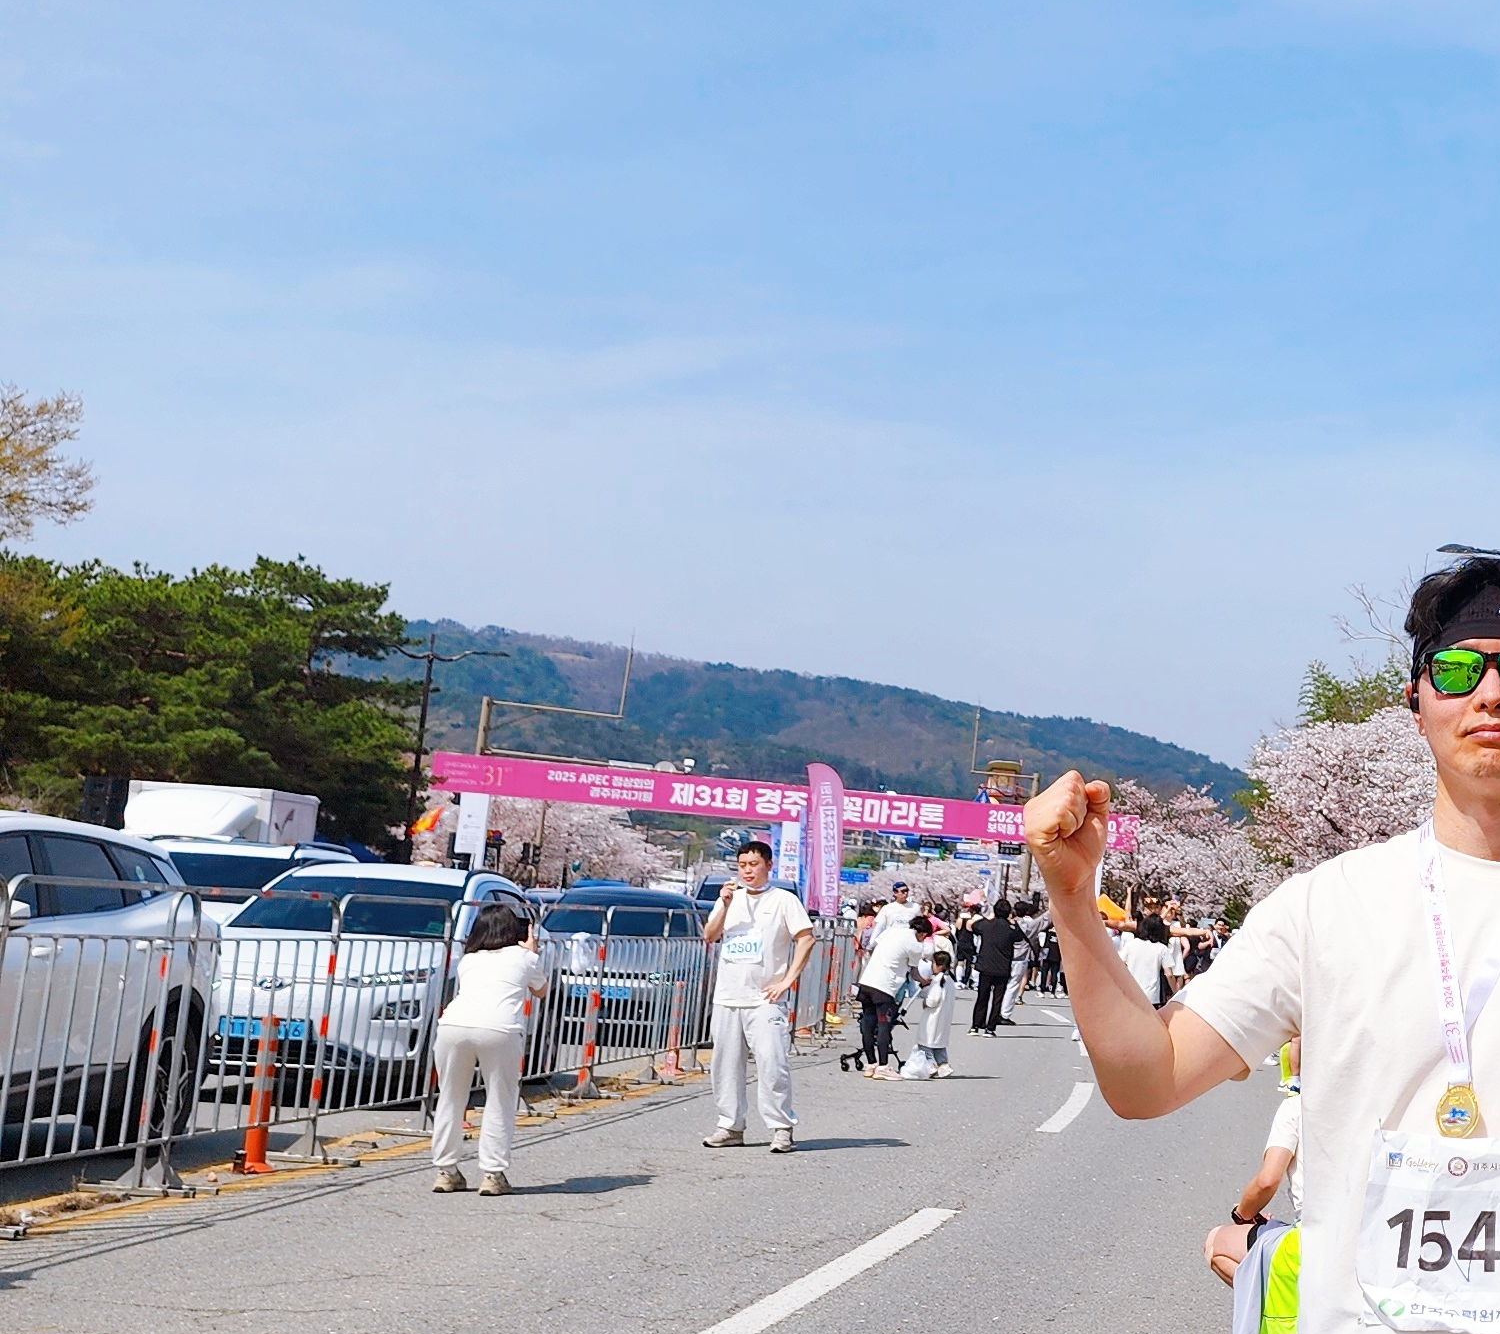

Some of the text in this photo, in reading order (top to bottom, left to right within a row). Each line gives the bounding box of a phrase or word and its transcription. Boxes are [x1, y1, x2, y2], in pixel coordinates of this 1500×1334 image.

[547, 770, 655, 790] 2025 APEC 정상회의
[669, 783, 749, 812] 제31회
